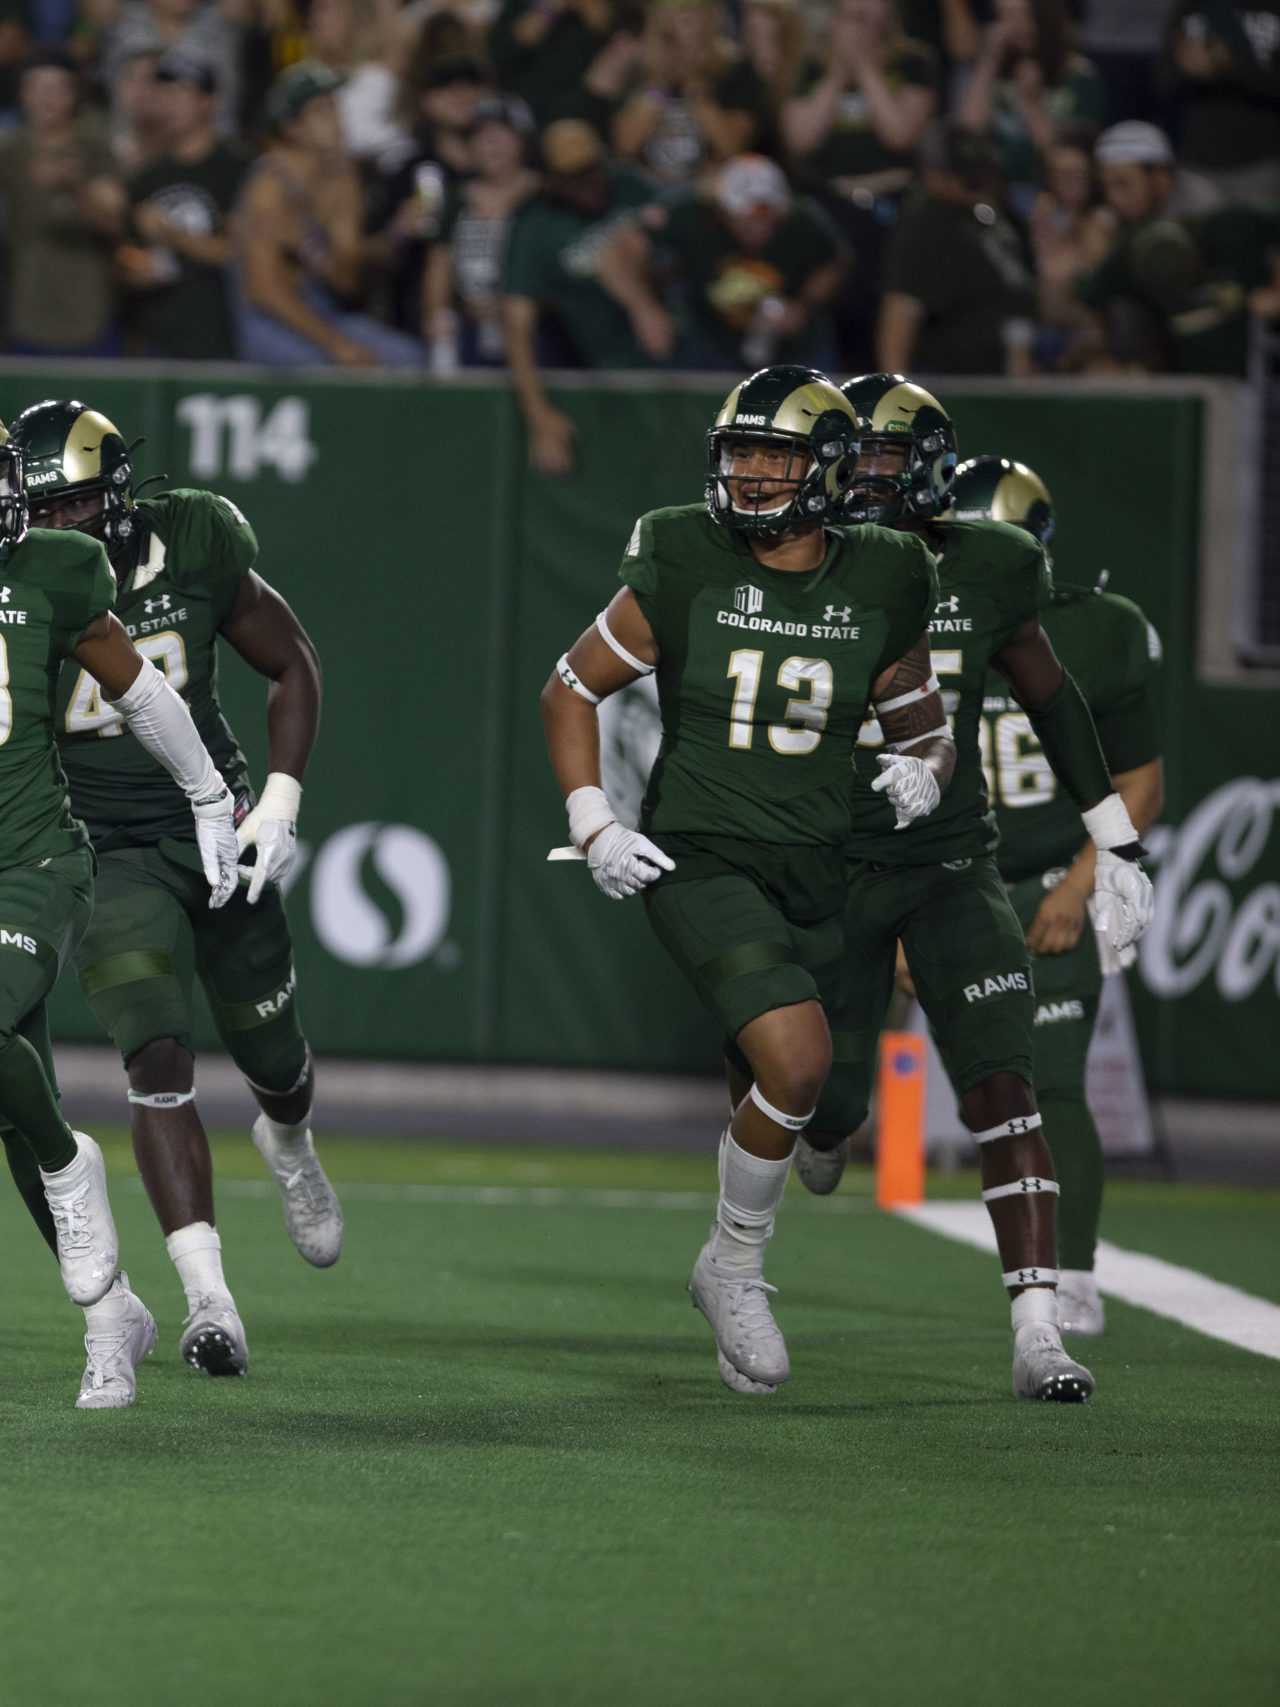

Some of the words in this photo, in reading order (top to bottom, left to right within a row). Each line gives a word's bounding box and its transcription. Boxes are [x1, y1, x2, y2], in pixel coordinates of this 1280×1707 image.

[735, 414, 766, 426] RAMS
[175, 393, 319, 481] 114
[26, 471, 58, 487] RAMS
[140, 607, 188, 633] STATE
[716, 610, 807, 637] COLORADO
[811, 625, 861, 640] STATE
[727, 648, 834, 756] 13
[1138, 776, 1280, 1000] Co
[255, 964, 297, 1018] RAM
[963, 972, 1029, 1003] RAMS
[1034, 999, 1084, 1026] AMS
